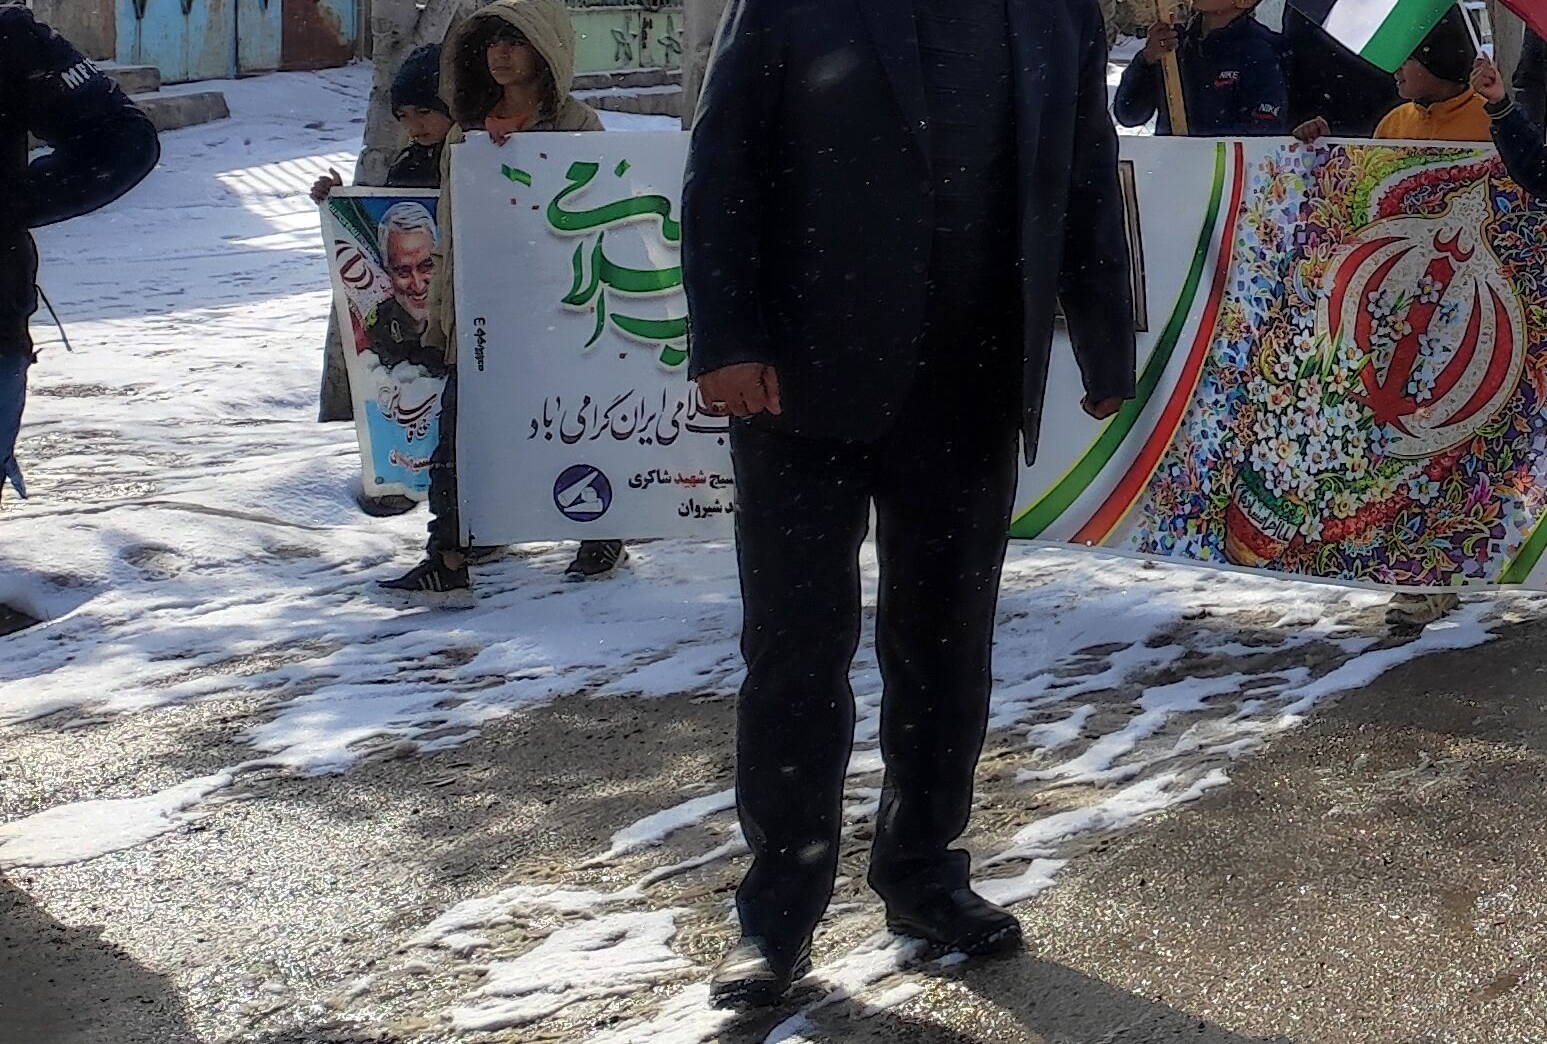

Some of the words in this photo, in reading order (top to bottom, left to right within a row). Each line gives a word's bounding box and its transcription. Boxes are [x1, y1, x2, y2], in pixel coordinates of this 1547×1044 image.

[527, 396, 561, 442] باد
[628, 468, 673, 489] شاکری
[674, 470, 707, 489] شهید
[677, 498, 722, 519] شیروان
